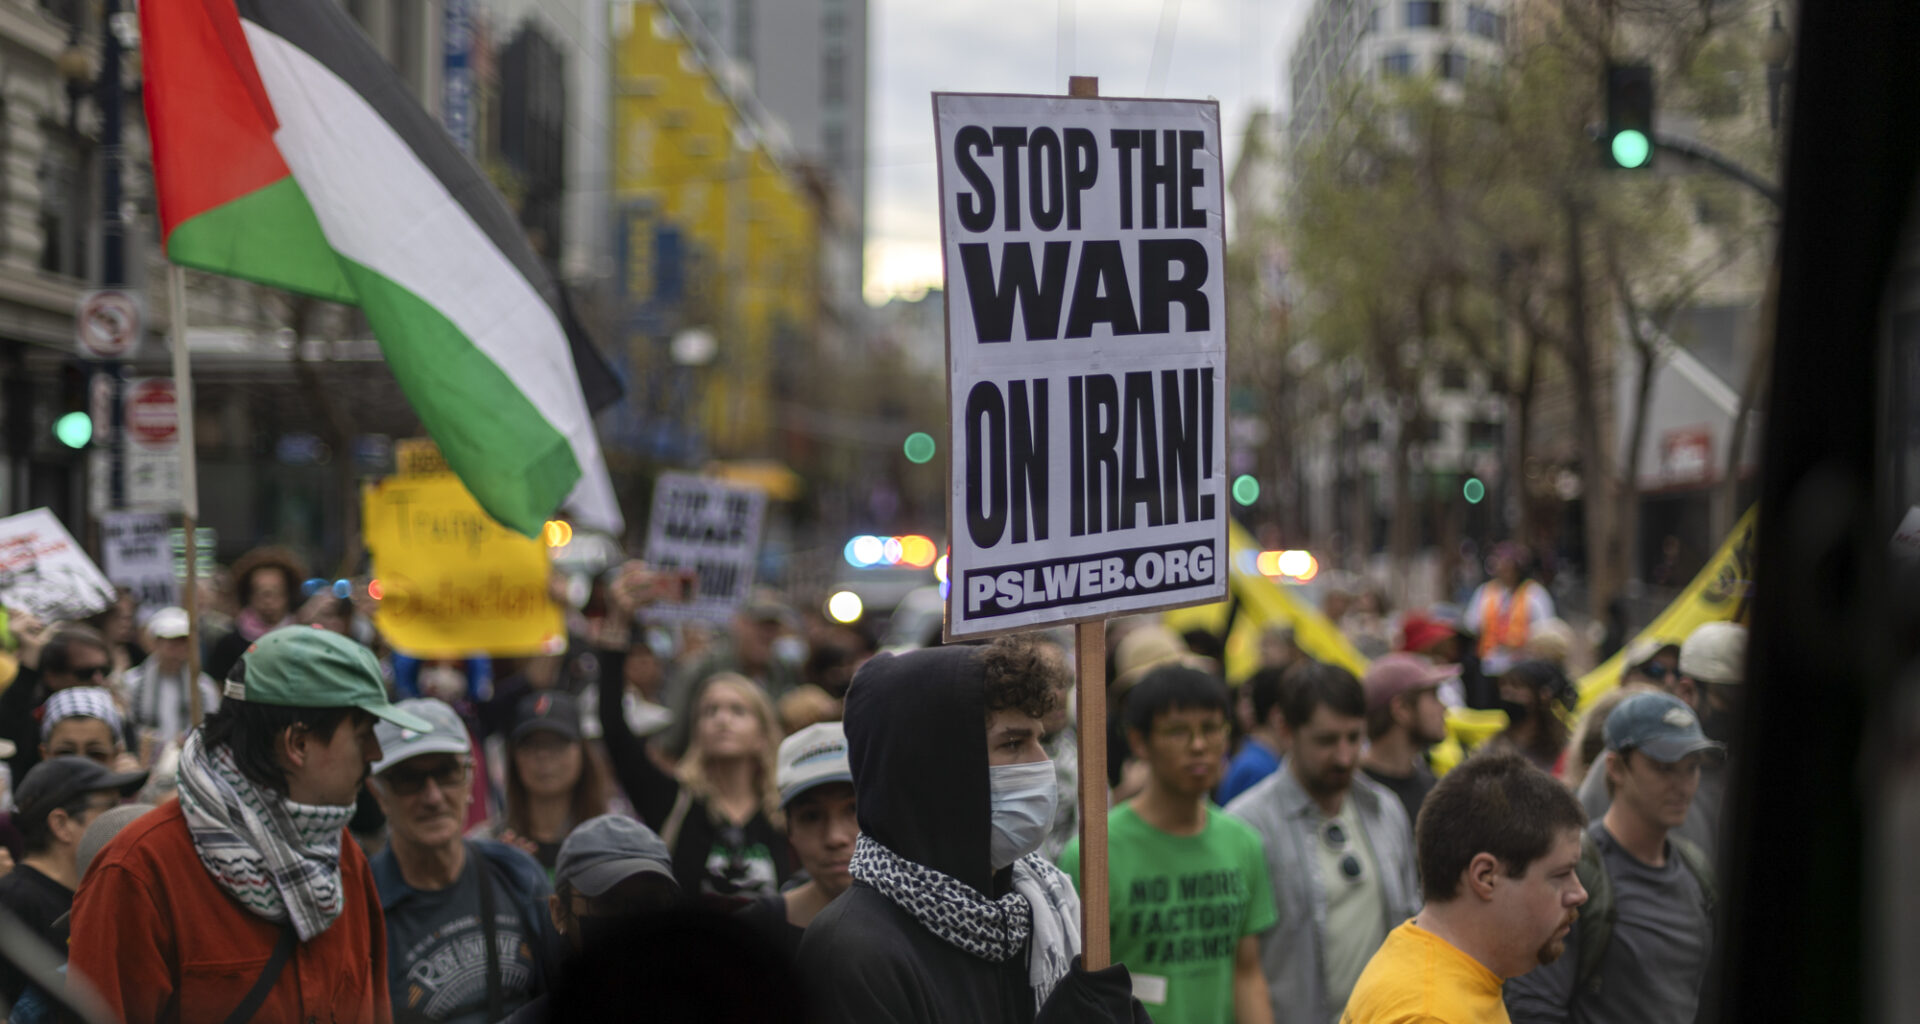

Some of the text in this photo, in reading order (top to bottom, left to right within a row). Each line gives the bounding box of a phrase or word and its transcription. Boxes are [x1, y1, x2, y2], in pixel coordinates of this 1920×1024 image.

[954, 125, 1207, 233] STOP THE
[958, 238, 1210, 343] WAR
[965, 367, 1215, 549] ON IRAN!
[967, 545, 1214, 612] PSLWEB.ORG
[1130, 876, 1170, 904] NO
